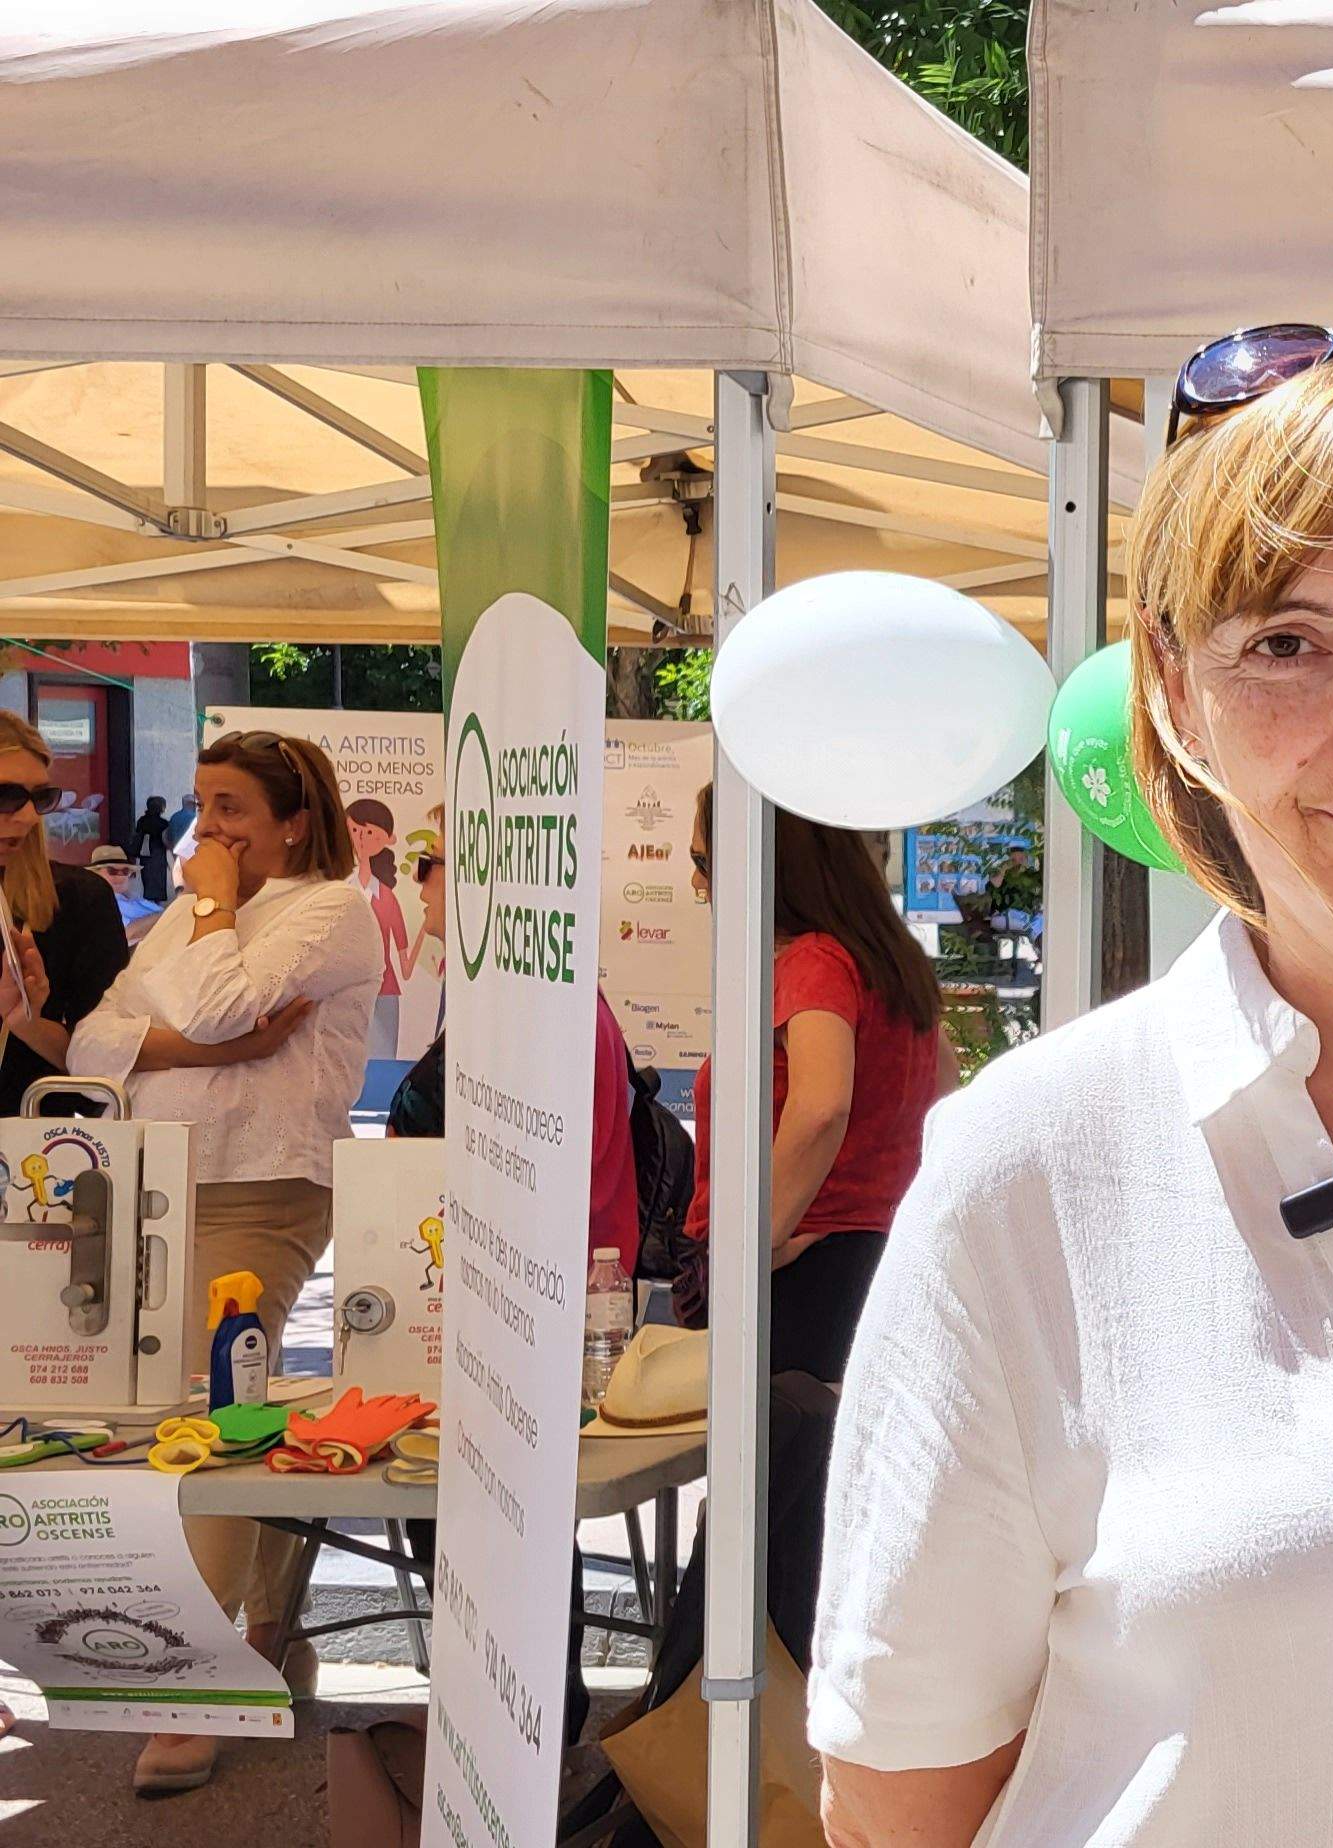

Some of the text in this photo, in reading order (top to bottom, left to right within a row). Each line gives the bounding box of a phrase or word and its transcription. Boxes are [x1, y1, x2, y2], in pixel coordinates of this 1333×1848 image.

[338, 735, 426, 756] ARTRITIS
[377, 761, 434, 776] MENOS
[496, 729, 578, 798] ASOCIACIÓN
[356, 779, 424, 796] ESPERAS
[456, 807, 492, 887] ARO
[494, 812, 578, 890] ARTRITIS
[636, 920, 672, 940] levar
[494, 902, 577, 984] OSCENSE
[655, 1022, 680, 1032] Mylan
[525, 1105, 564, 1146] parece
[43, 1127, 68, 1141] OSCA
[92, 1139, 111, 1168] JUSTO
[27, 1240, 72, 1254] cerraj
[523, 1259, 566, 1310] vencido,
[409, 1326, 434, 1334] OSCA
[10, 1345, 39, 1353] OSCA
[75, 1345, 109, 1354] JUSTO
[24, 1354, 96, 1362] CERRAJEROS
[505, 1383, 539, 1450] Oscense
[31, 1496, 109, 1510] ASOCIACIÓN
[34, 1511, 111, 1527] ARTRITIS
[36, 1527, 116, 1541] OSCENSE
[9, 1589, 34, 1599] 862
[35, 1588, 62, 1598] 073
[79, 1586, 105, 1595] 974
[107, 1585, 133, 1594] 042
[135, 1584, 162, 1593] 364
[92, 1637, 142, 1651] ARO
[484, 1628, 498, 1689] 974
[499, 1653, 517, 1722] 042
[518, 1684, 543, 1755] 364
